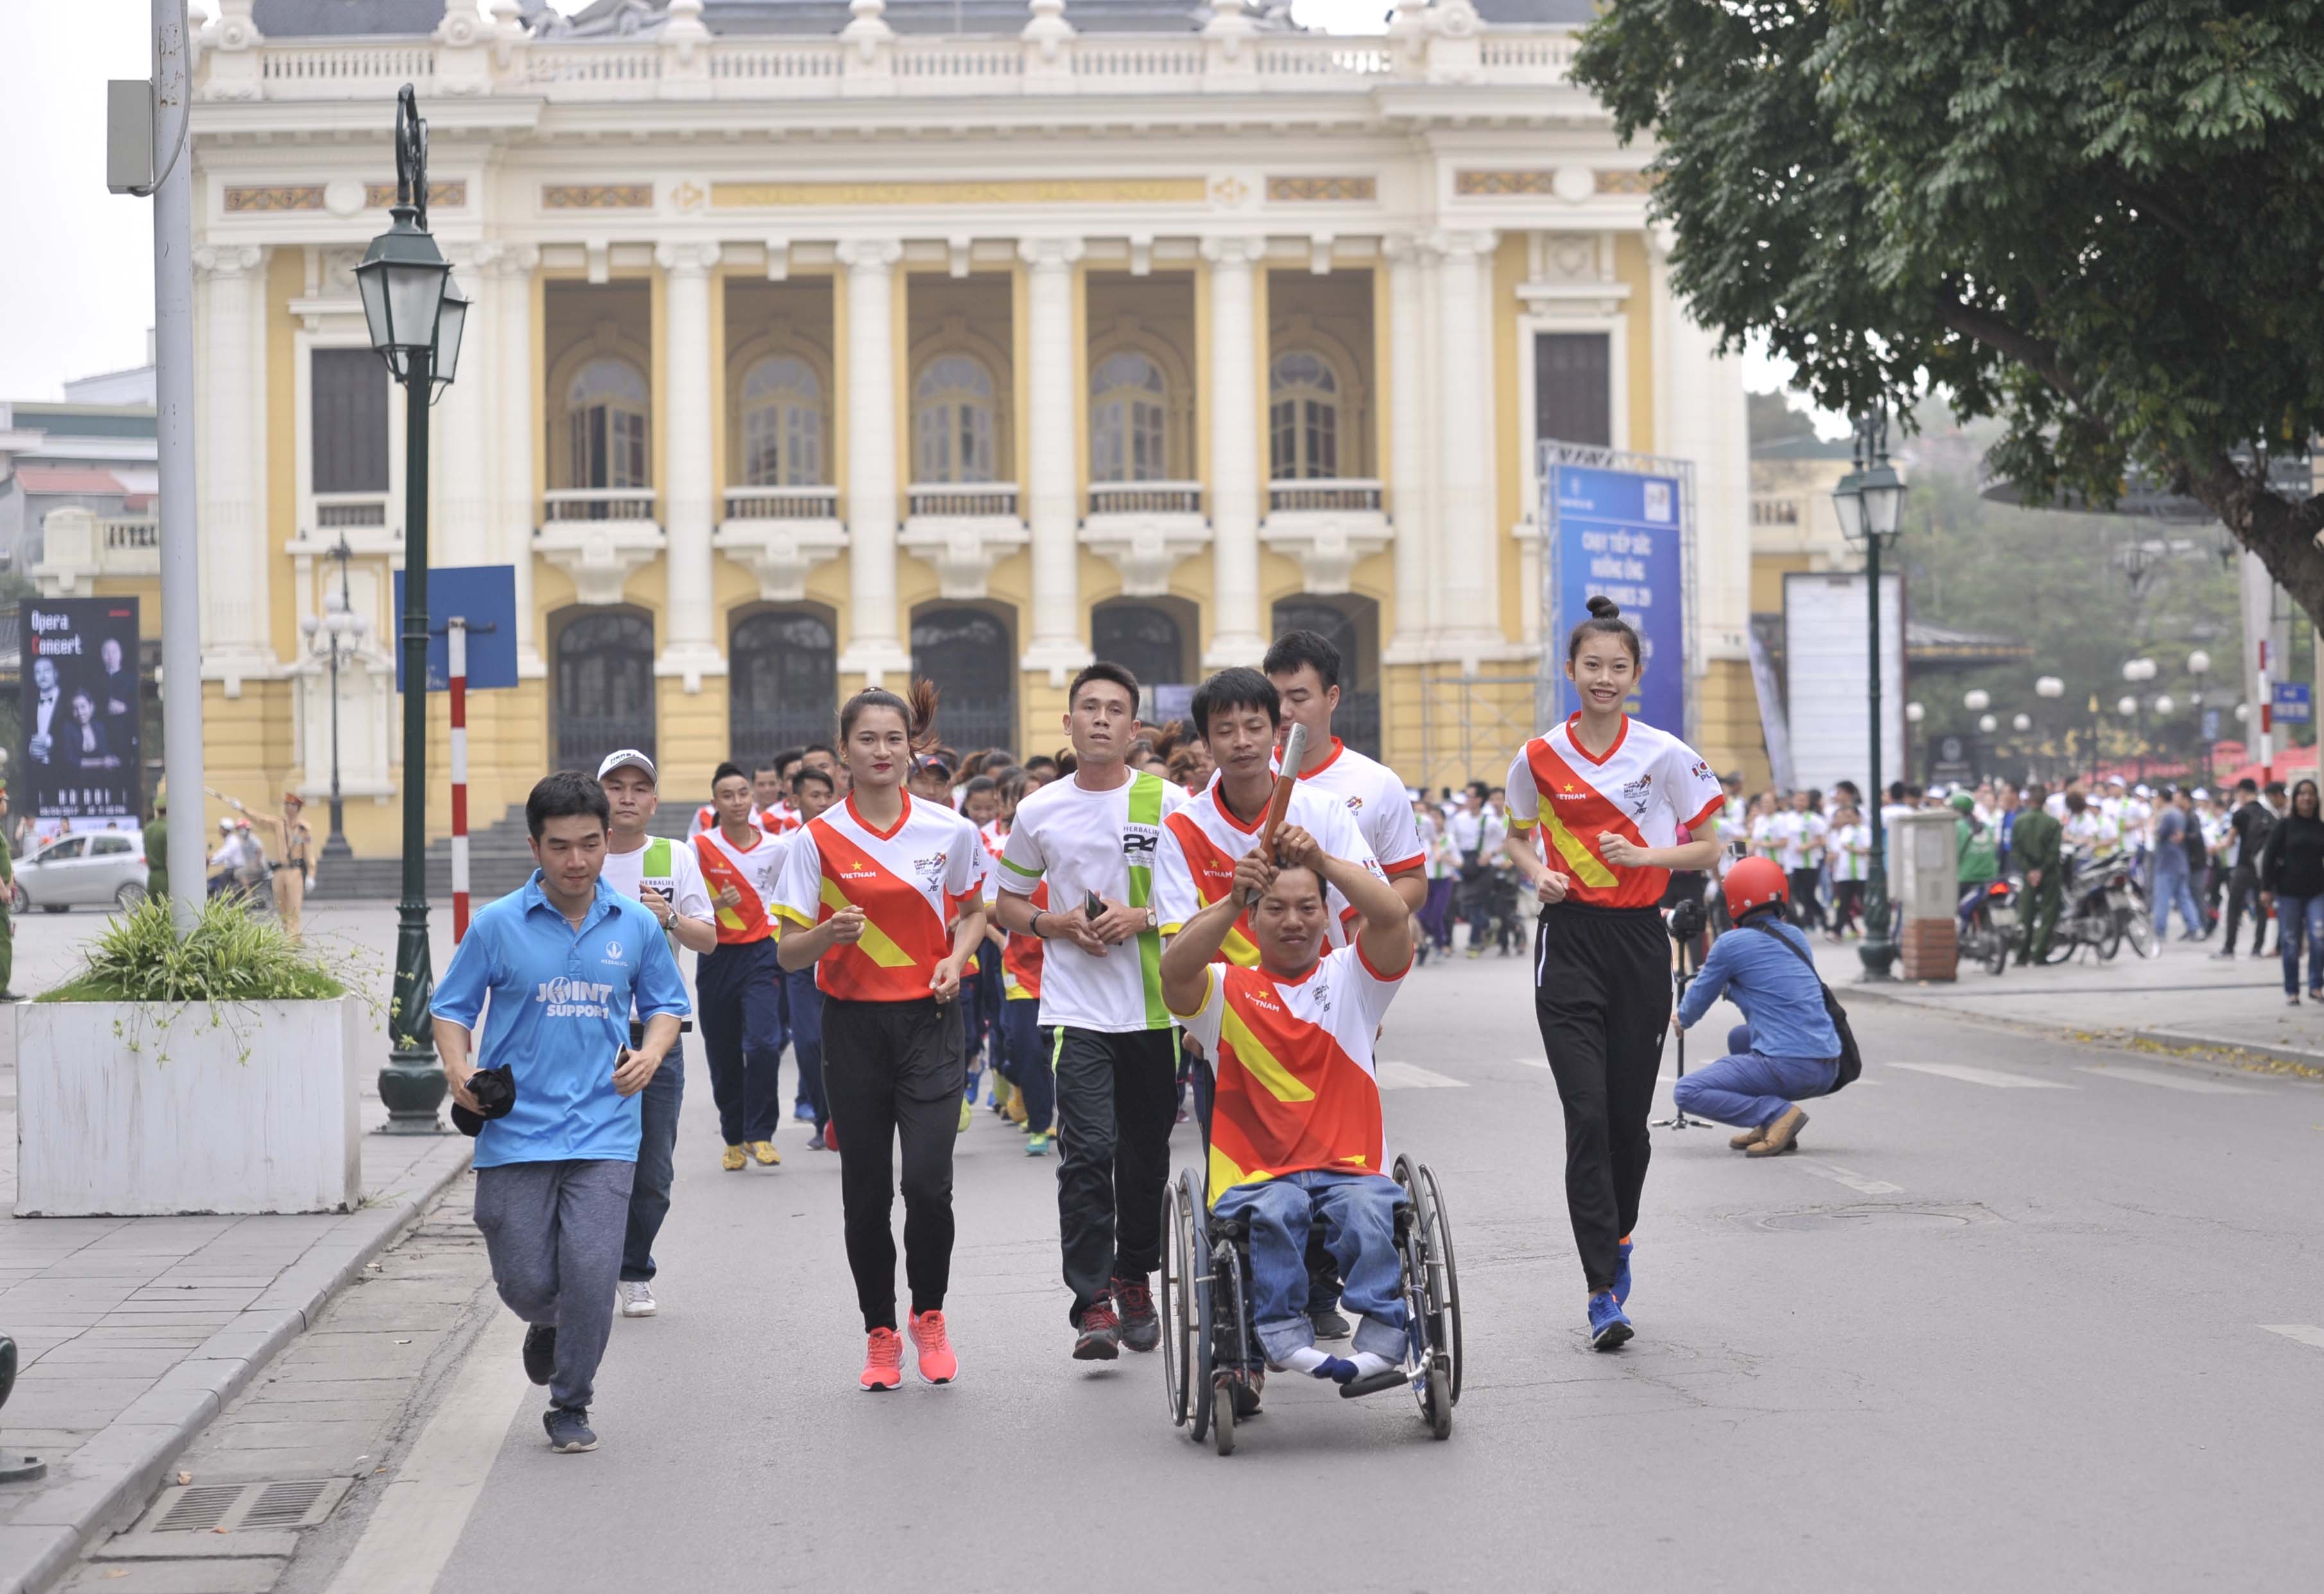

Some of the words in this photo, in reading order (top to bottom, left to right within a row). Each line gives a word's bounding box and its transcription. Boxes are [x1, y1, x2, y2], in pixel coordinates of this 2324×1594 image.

[31, 610, 69, 635] Opera
[32, 634, 82, 655] Concert
[1701, 771, 1716, 782] PLU
[1123, 834, 1158, 853] 24
[839, 871, 877, 879] VIETNAM
[535, 976, 614, 1005] JOINT
[546, 1004, 609, 1019] SUPPORT
